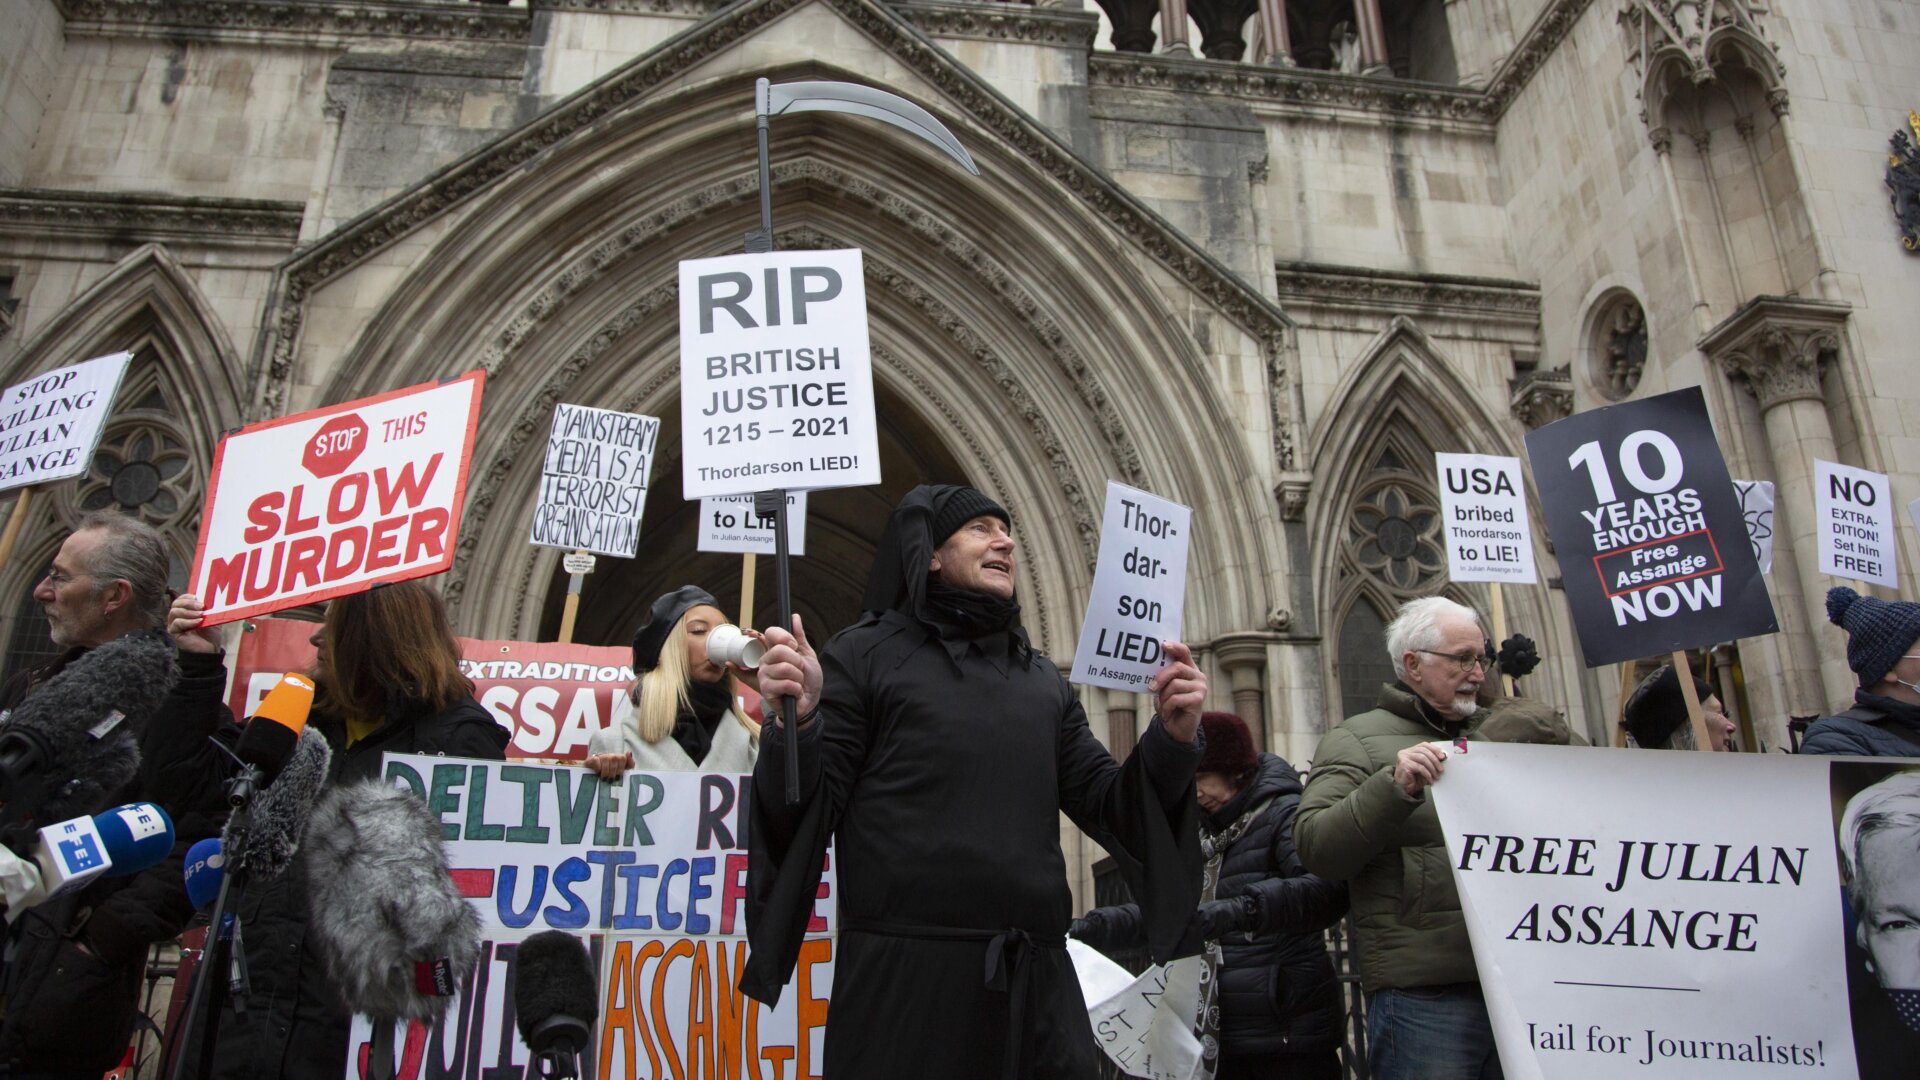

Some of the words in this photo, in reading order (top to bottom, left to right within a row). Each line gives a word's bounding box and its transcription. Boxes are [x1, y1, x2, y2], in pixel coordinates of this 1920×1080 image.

[698, 266, 843, 335] RIP
[706, 347, 840, 380] BRITISH
[15, 371, 78, 405] STOP
[702, 382, 848, 416] JUSTICE
[315, 427, 361, 457] STOP
[382, 411, 428, 443] THIS
[551, 405, 658, 454] MAINSTREAM
[703, 422, 761, 446] 1215
[792, 417, 849, 437] 2021
[545, 439, 600, 479] MEDIA
[608, 448, 631, 481] IS
[630, 455, 654, 486] A
[698, 459, 803, 482] Thordarson
[809, 455, 859, 471] LIED!
[1568, 429, 1684, 504] 10
[244, 452, 444, 544] SLOW
[544, 473, 646, 517] TERRORIST
[1446, 468, 1516, 496] USA
[1830, 474, 1876, 507] NO
[714, 510, 736, 528] to
[1121, 499, 1177, 539] Thor-
[1455, 505, 1514, 523] bribed
[1581, 488, 1702, 532] YEARS
[1831, 508, 1878, 526] EXTRA-
[533, 504, 641, 554] ORGANISATION
[743, 535, 773, 544] Assange
[1452, 527, 1522, 540] Thordarson
[1592, 512, 1707, 551] ENOUGH
[1833, 523, 1879, 543] DITION!
[203, 507, 450, 610] MURDER
[1124, 547, 1167, 579] dar-
[1459, 545, 1478, 560] to
[1484, 545, 1519, 562] LIE!
[1631, 544, 1679, 566] Free
[1834, 539, 1854, 553] Set
[1858, 544, 1880, 558] him
[1616, 555, 1707, 588] Assange
[1834, 554, 1882, 577] FREE!
[1117, 595, 1162, 623] son
[1610, 575, 1722, 626] NOW
[1096, 628, 1166, 667] LIED!
[1088, 664, 1097, 676] In
[1100, 667, 1142, 684] Assange
[1458, 834, 1598, 877] FREE
[1605, 840, 1809, 891] JULIAN
[1506, 903, 1759, 952] ASSANGE
[1526, 1023, 1575, 1051] Jail
[1586, 1026, 1631, 1054] for
[1640, 1030, 1826, 1067] Journalists!
